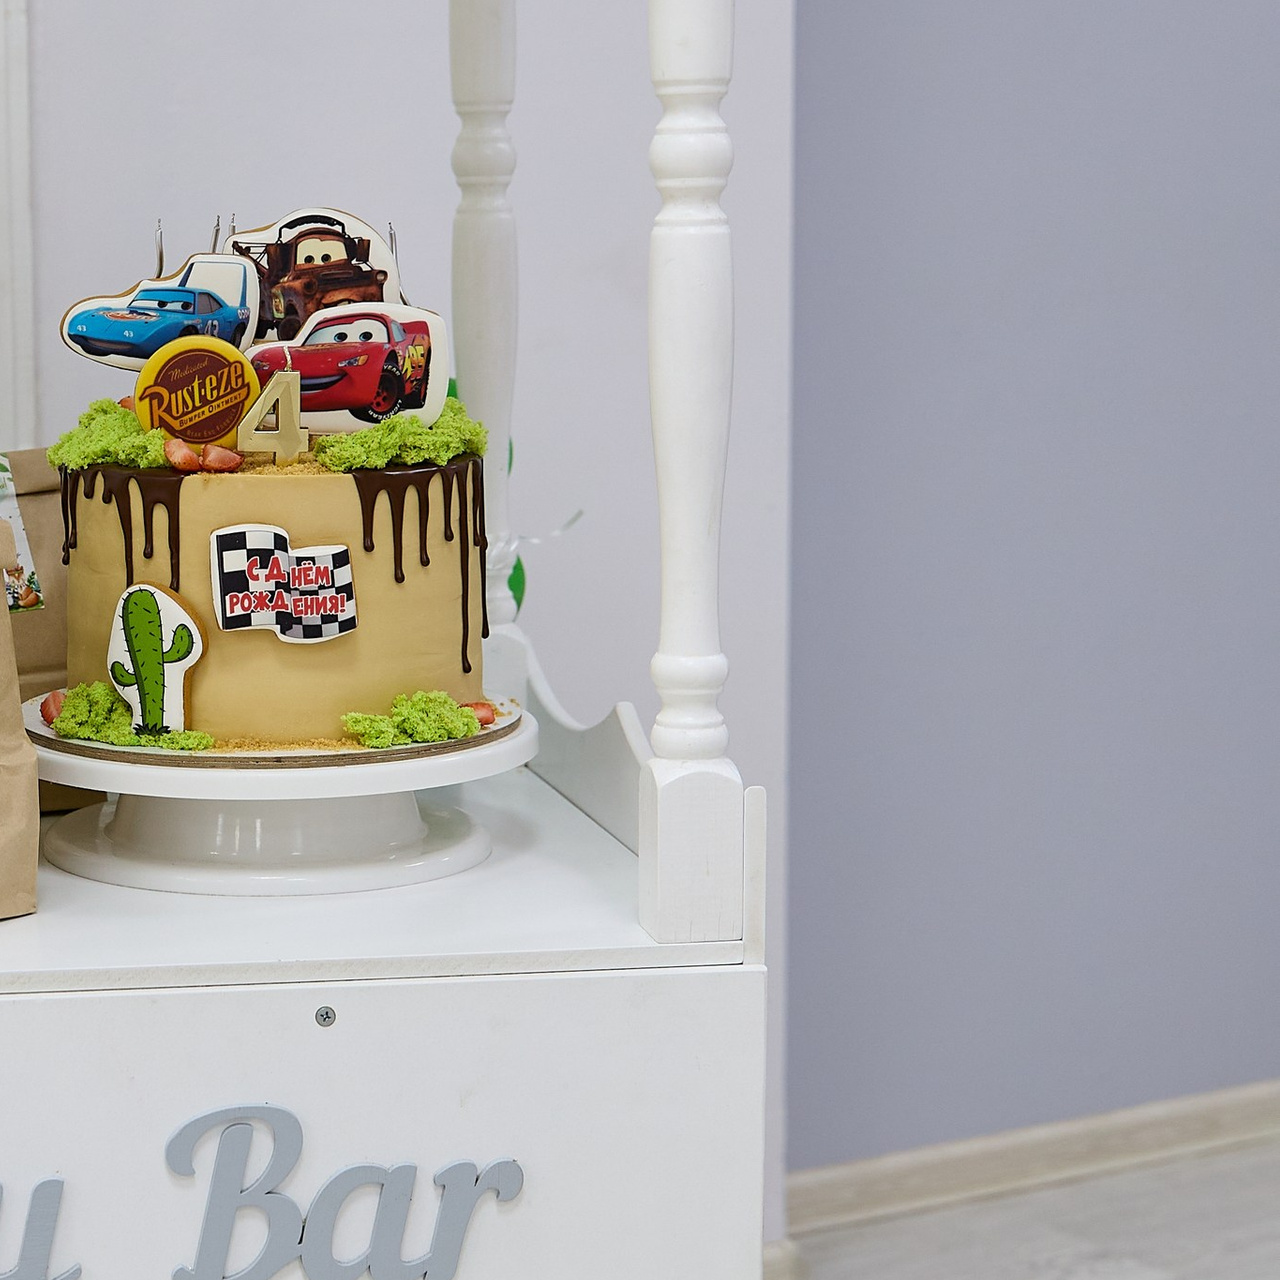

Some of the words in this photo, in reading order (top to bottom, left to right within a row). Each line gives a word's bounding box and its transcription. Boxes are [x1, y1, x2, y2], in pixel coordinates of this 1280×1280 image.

[168, 357, 209, 382] Medicated
[237, 370, 310, 466] 4
[246, 556, 260, 582] С
[227, 588, 347, 618] РОЖДЕНИЯ!
